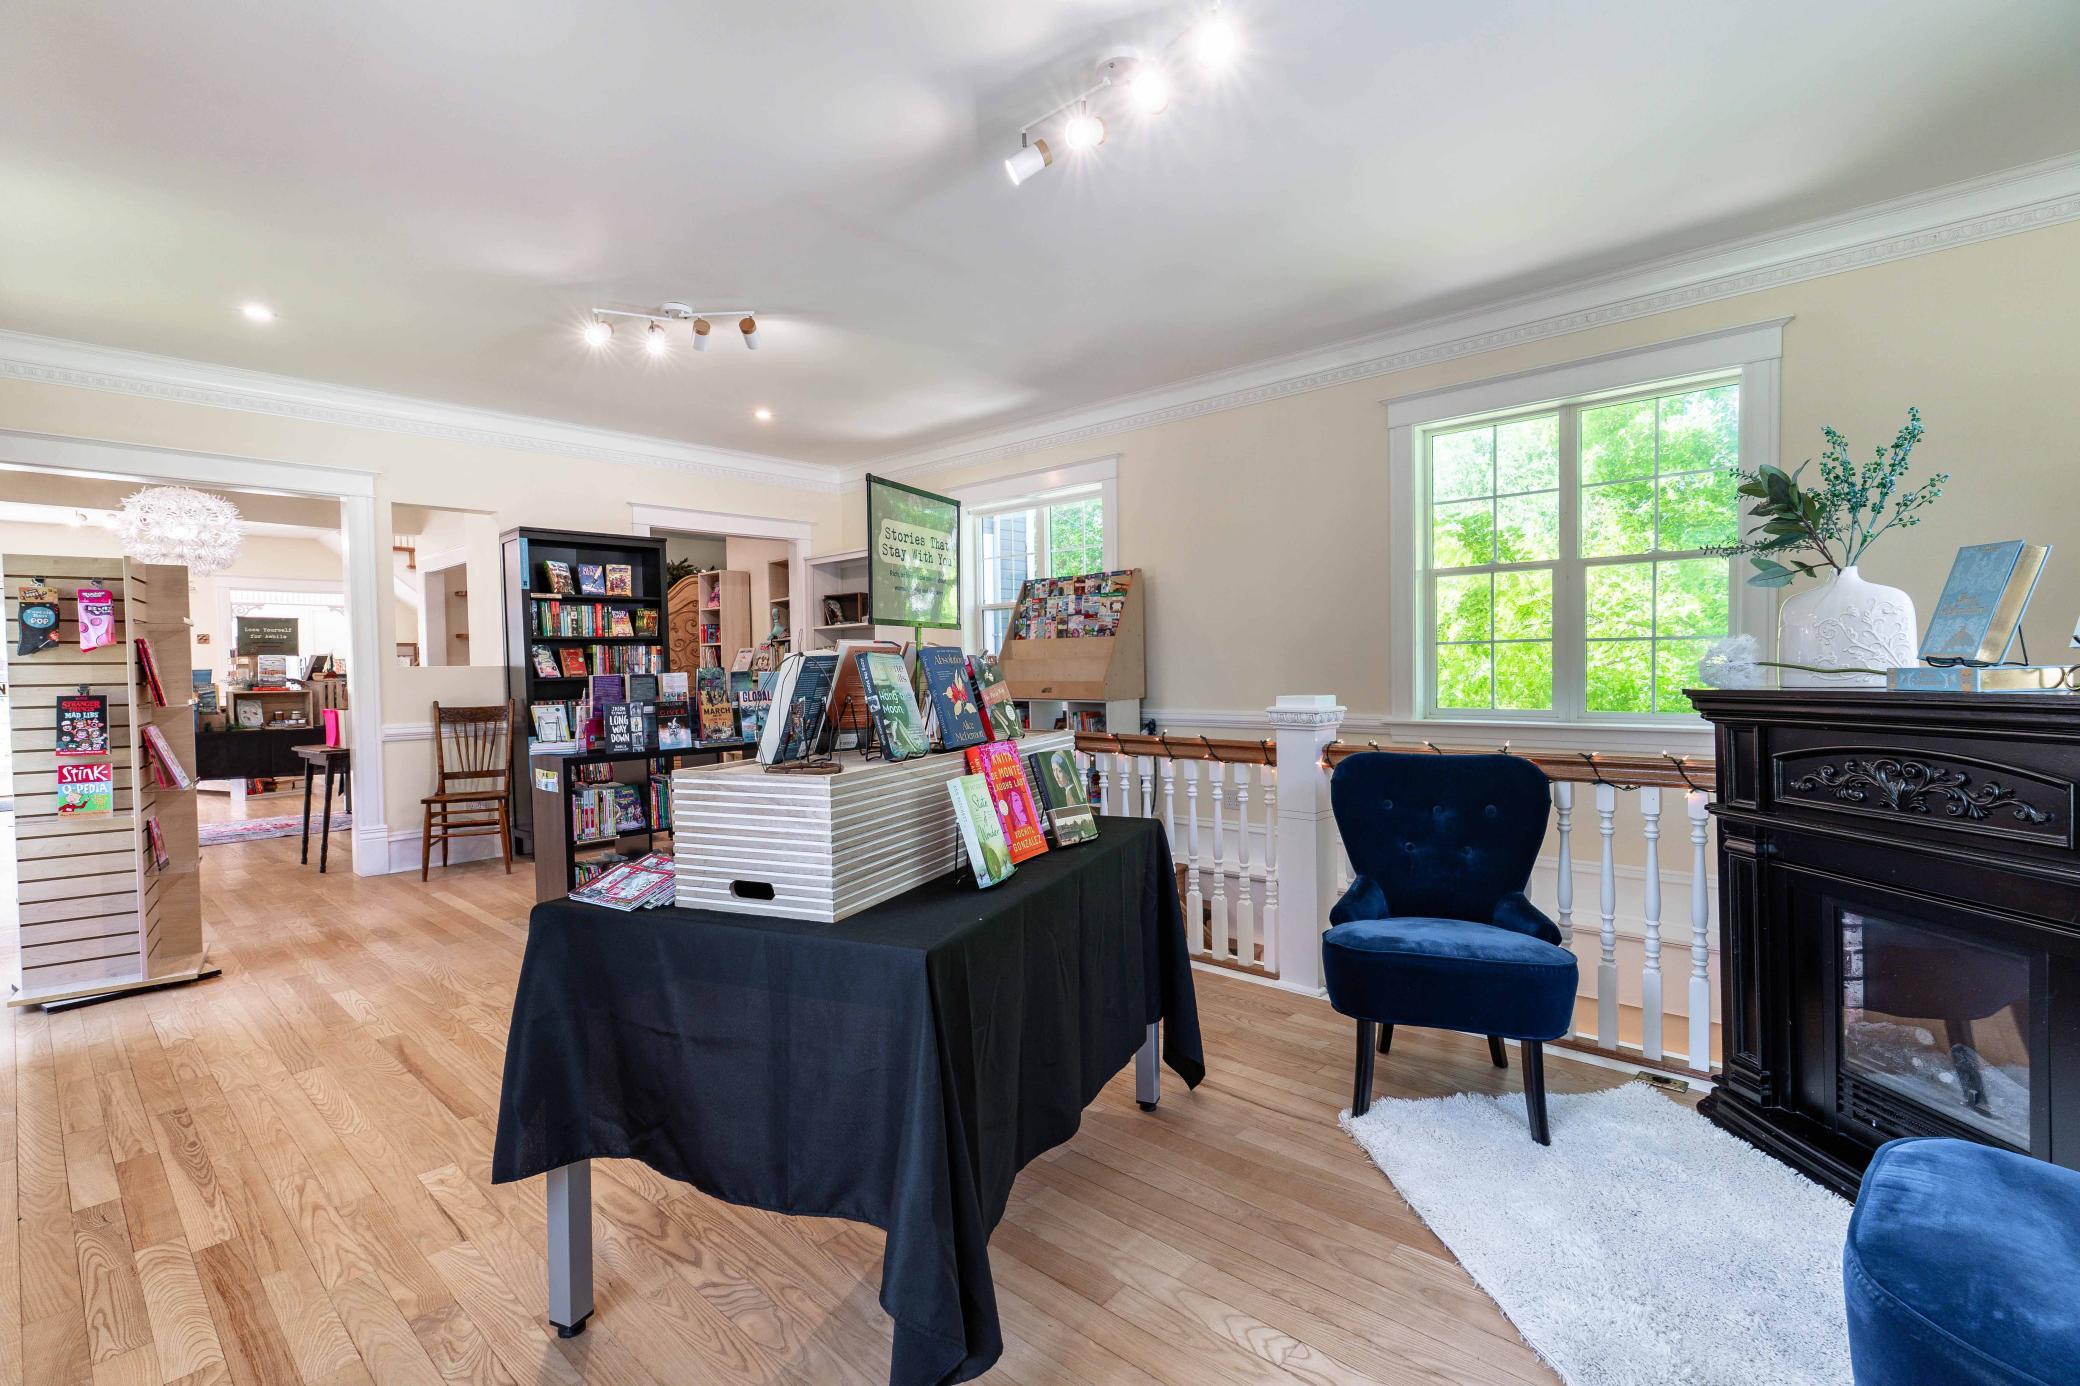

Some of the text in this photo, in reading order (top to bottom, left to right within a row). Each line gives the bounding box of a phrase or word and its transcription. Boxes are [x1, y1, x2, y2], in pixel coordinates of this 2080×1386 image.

[884, 527, 949, 551] Stories That
[882, 543, 952, 567] Stay With You
[742, 690, 772, 703] GLOBAL
[879, 690, 899, 704] Hang
[62, 701, 101, 709] STRANGER
[703, 707, 731, 715] MARCH
[882, 705, 904, 714] Moon
[609, 715, 629, 726] LONG
[612, 725, 627, 734] WAY
[610, 734, 630, 743] DOWN
[992, 753, 1013, 763] ANITA
[991, 765, 1021, 780] DE MONTE
[62, 783, 108, 795] O-PEDIA
[994, 781, 1013, 791] LAUGHS
[1014, 778, 1025, 788] LAST
[1012, 835, 1042, 852] GONZALEZ
